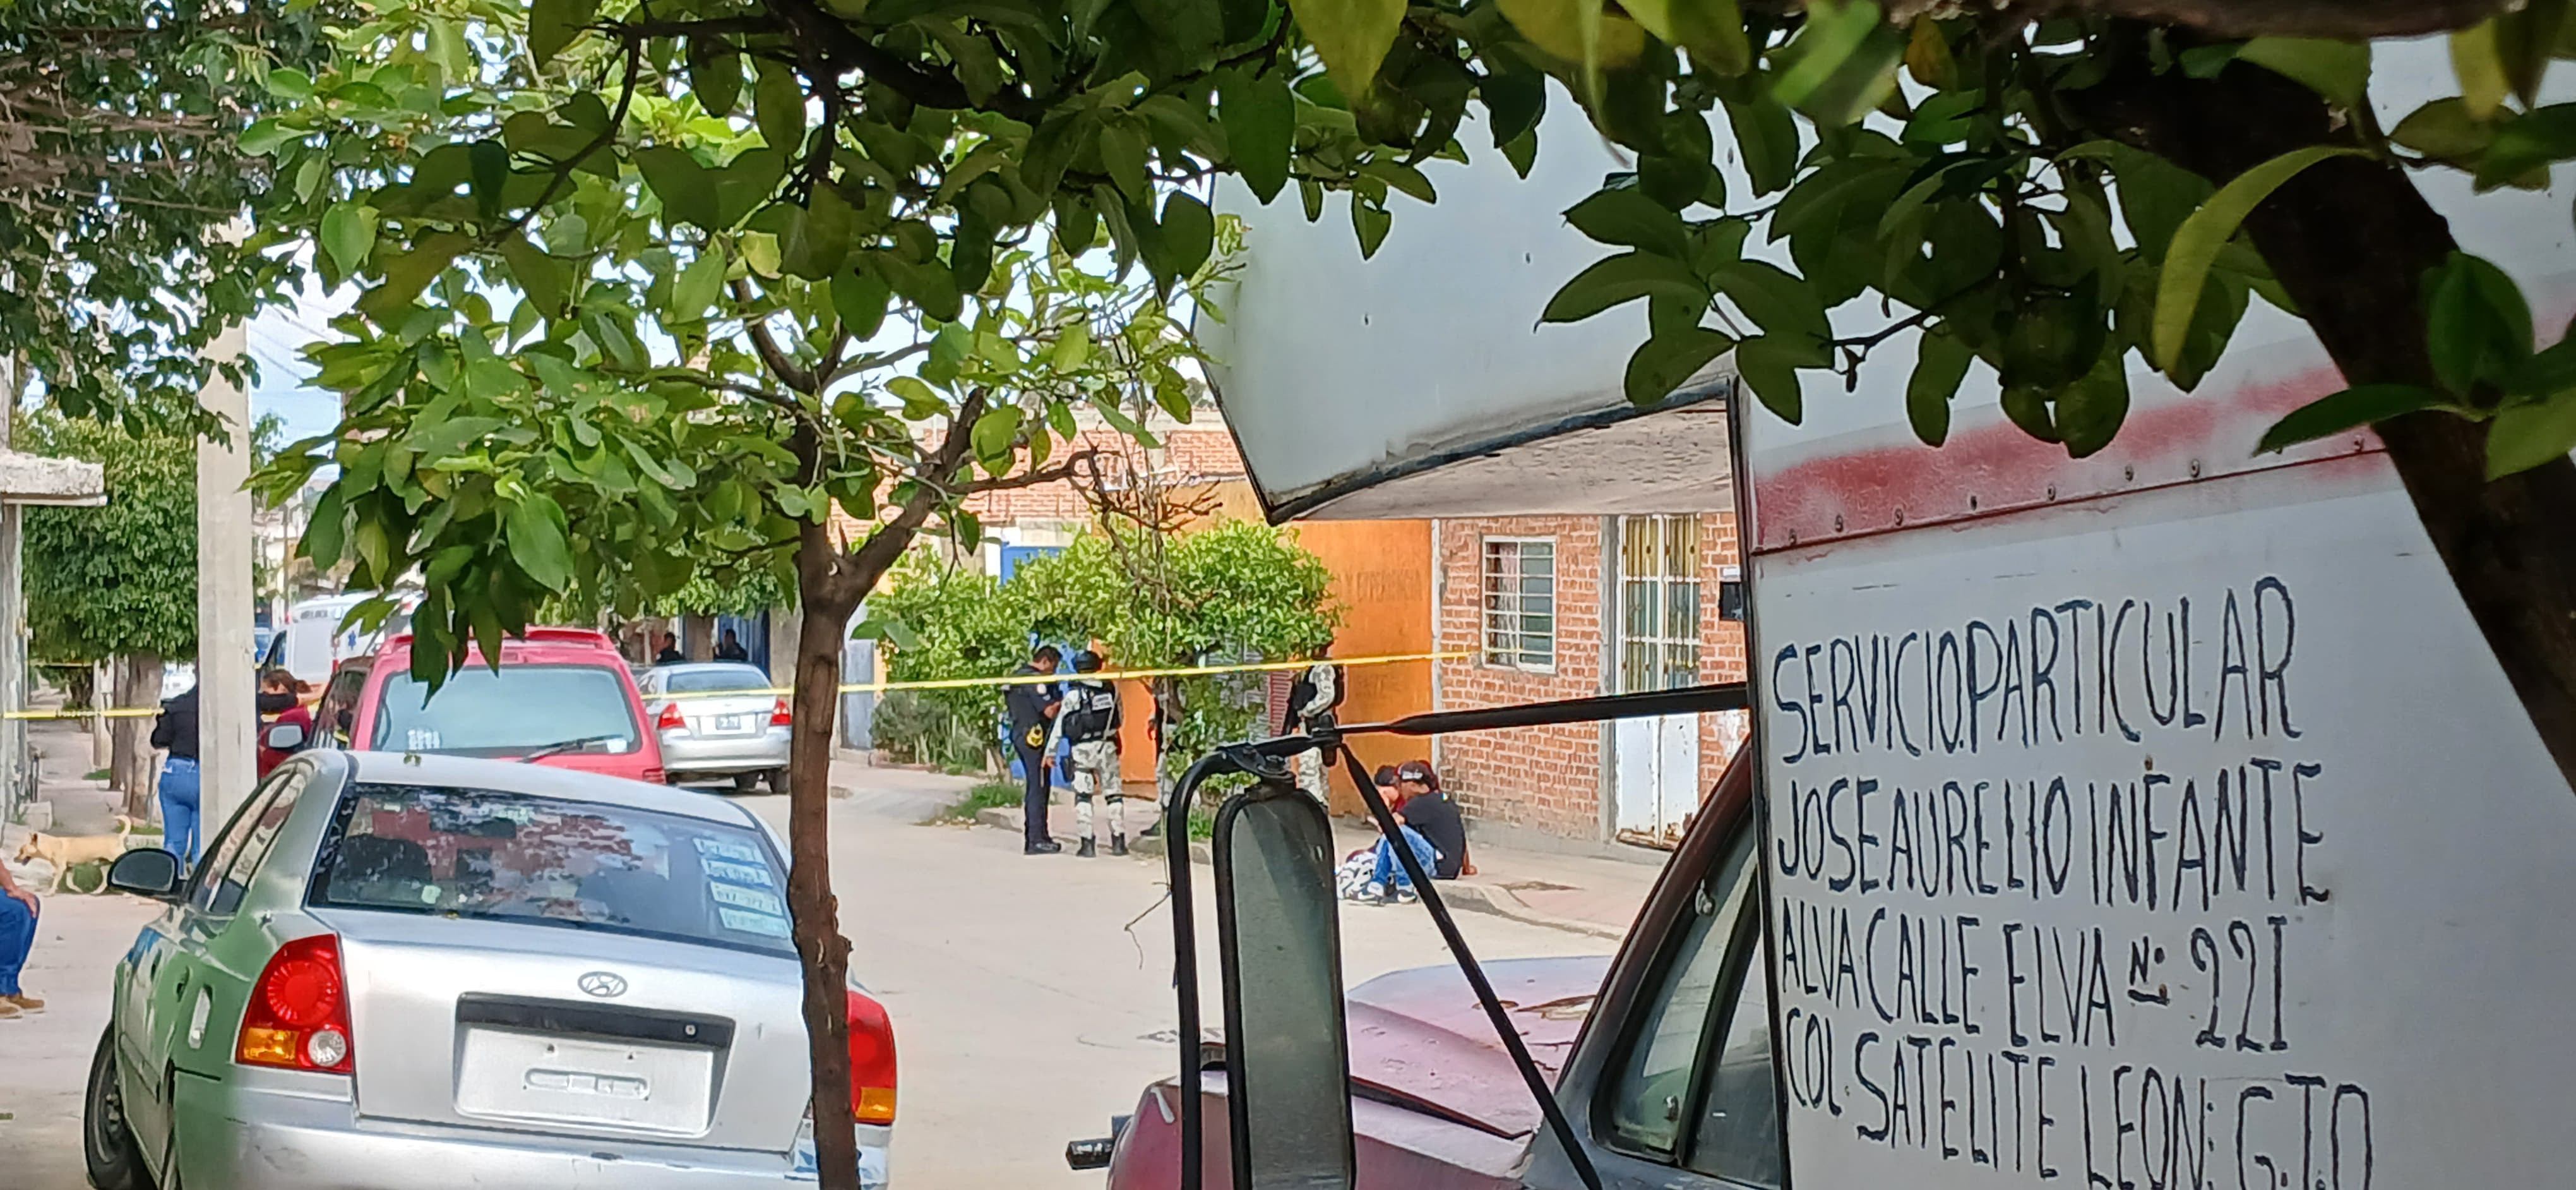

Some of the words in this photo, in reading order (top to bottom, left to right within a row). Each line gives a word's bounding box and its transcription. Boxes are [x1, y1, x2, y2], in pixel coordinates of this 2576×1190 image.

[1965, 576, 2302, 754] PARTICULAR
[1778, 778, 1881, 894] JOSE
[1887, 776, 2072, 899] AURELIO
[2089, 758, 2330, 911] INFANTE
[1782, 897, 1859, 1009] ALVA
[1866, 907, 1981, 1035] CALLE
[2003, 923, 2115, 1048] ELVA
[1854, 1031, 2060, 1179] SATELITE
